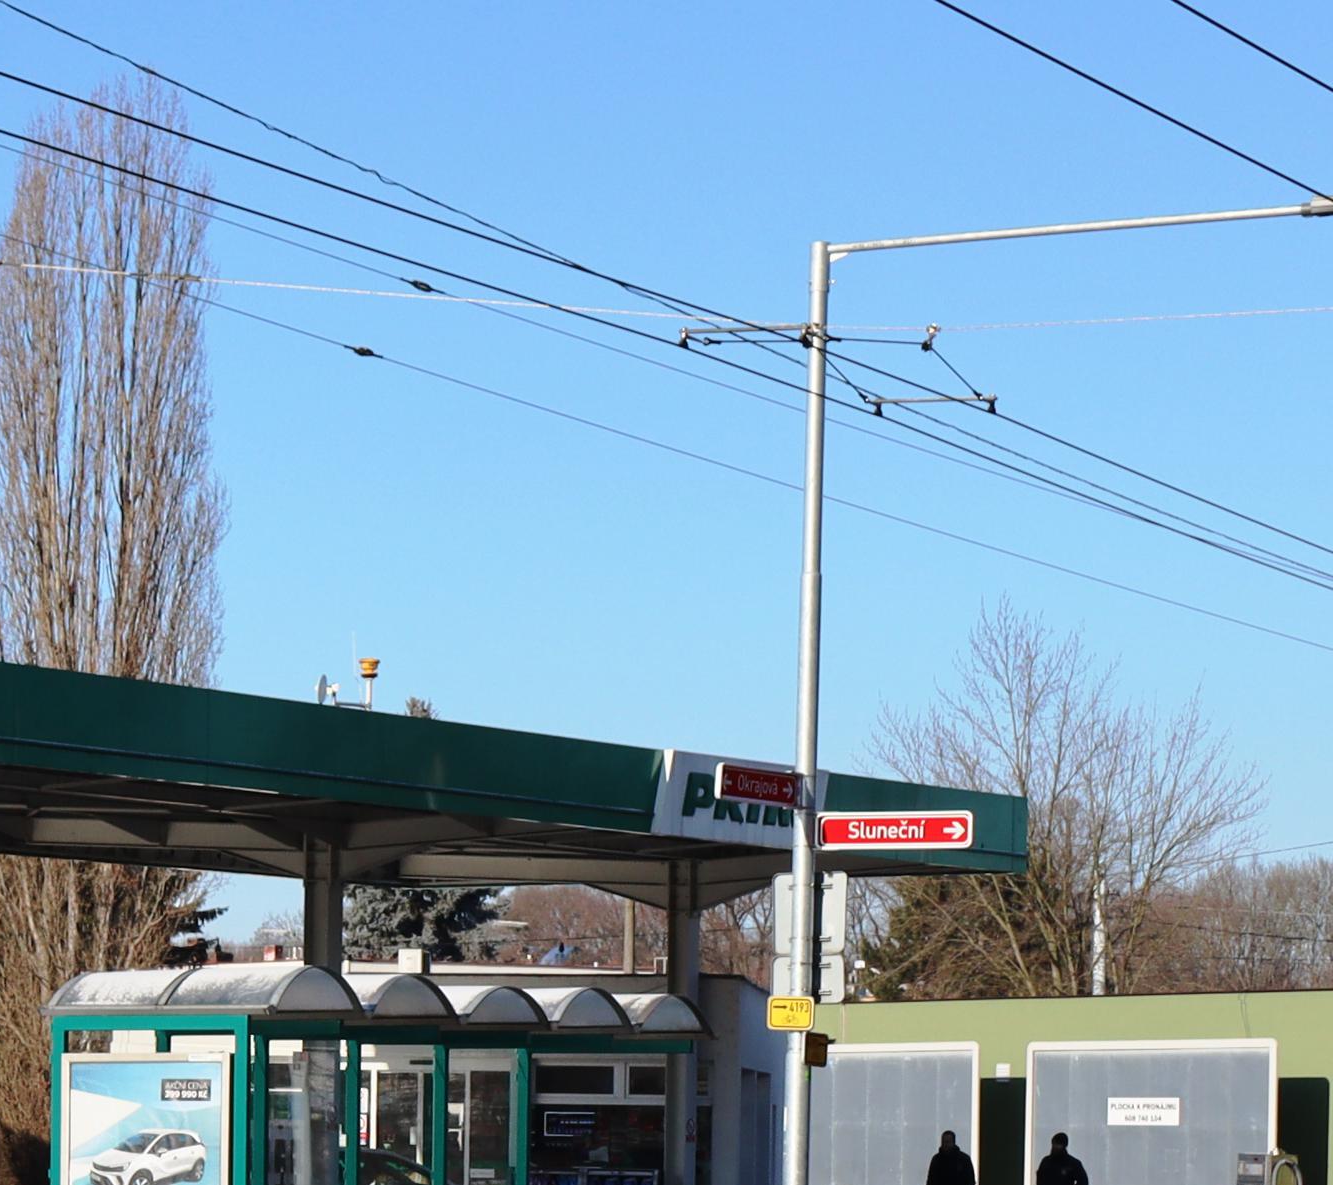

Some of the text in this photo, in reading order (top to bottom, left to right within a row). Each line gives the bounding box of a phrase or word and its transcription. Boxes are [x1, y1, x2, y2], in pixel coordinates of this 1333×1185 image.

[737, 774, 779, 796] Okrajová
[847, 820, 926, 840] Sluneční
[789, 1002, 809, 1013] 4193
